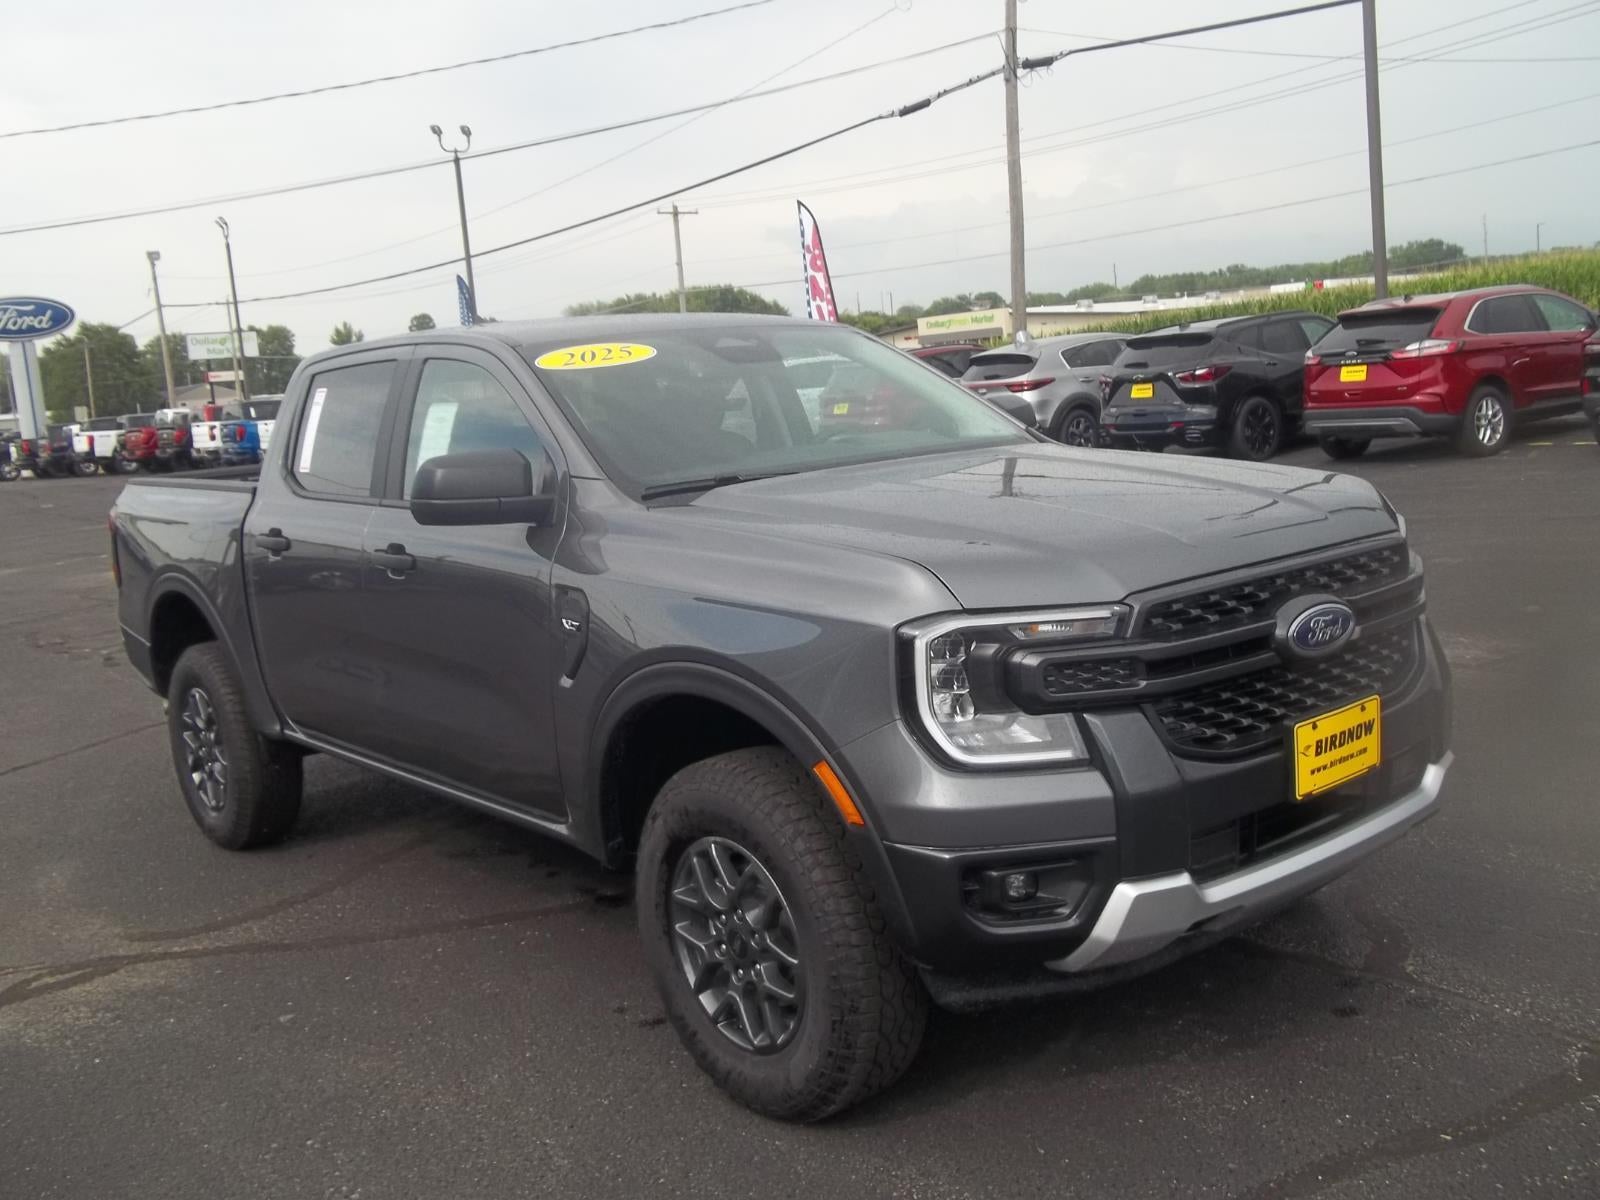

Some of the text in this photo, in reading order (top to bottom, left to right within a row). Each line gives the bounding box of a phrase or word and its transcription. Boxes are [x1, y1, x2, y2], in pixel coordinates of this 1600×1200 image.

[0, 305, 53, 330] Ford
[562, 345, 633, 366] 2025
[1308, 614, 1342, 645] Ford
[1315, 717, 1375, 758] BIRDNOW
[1310, 746, 1368, 776] www.birdnow.com
